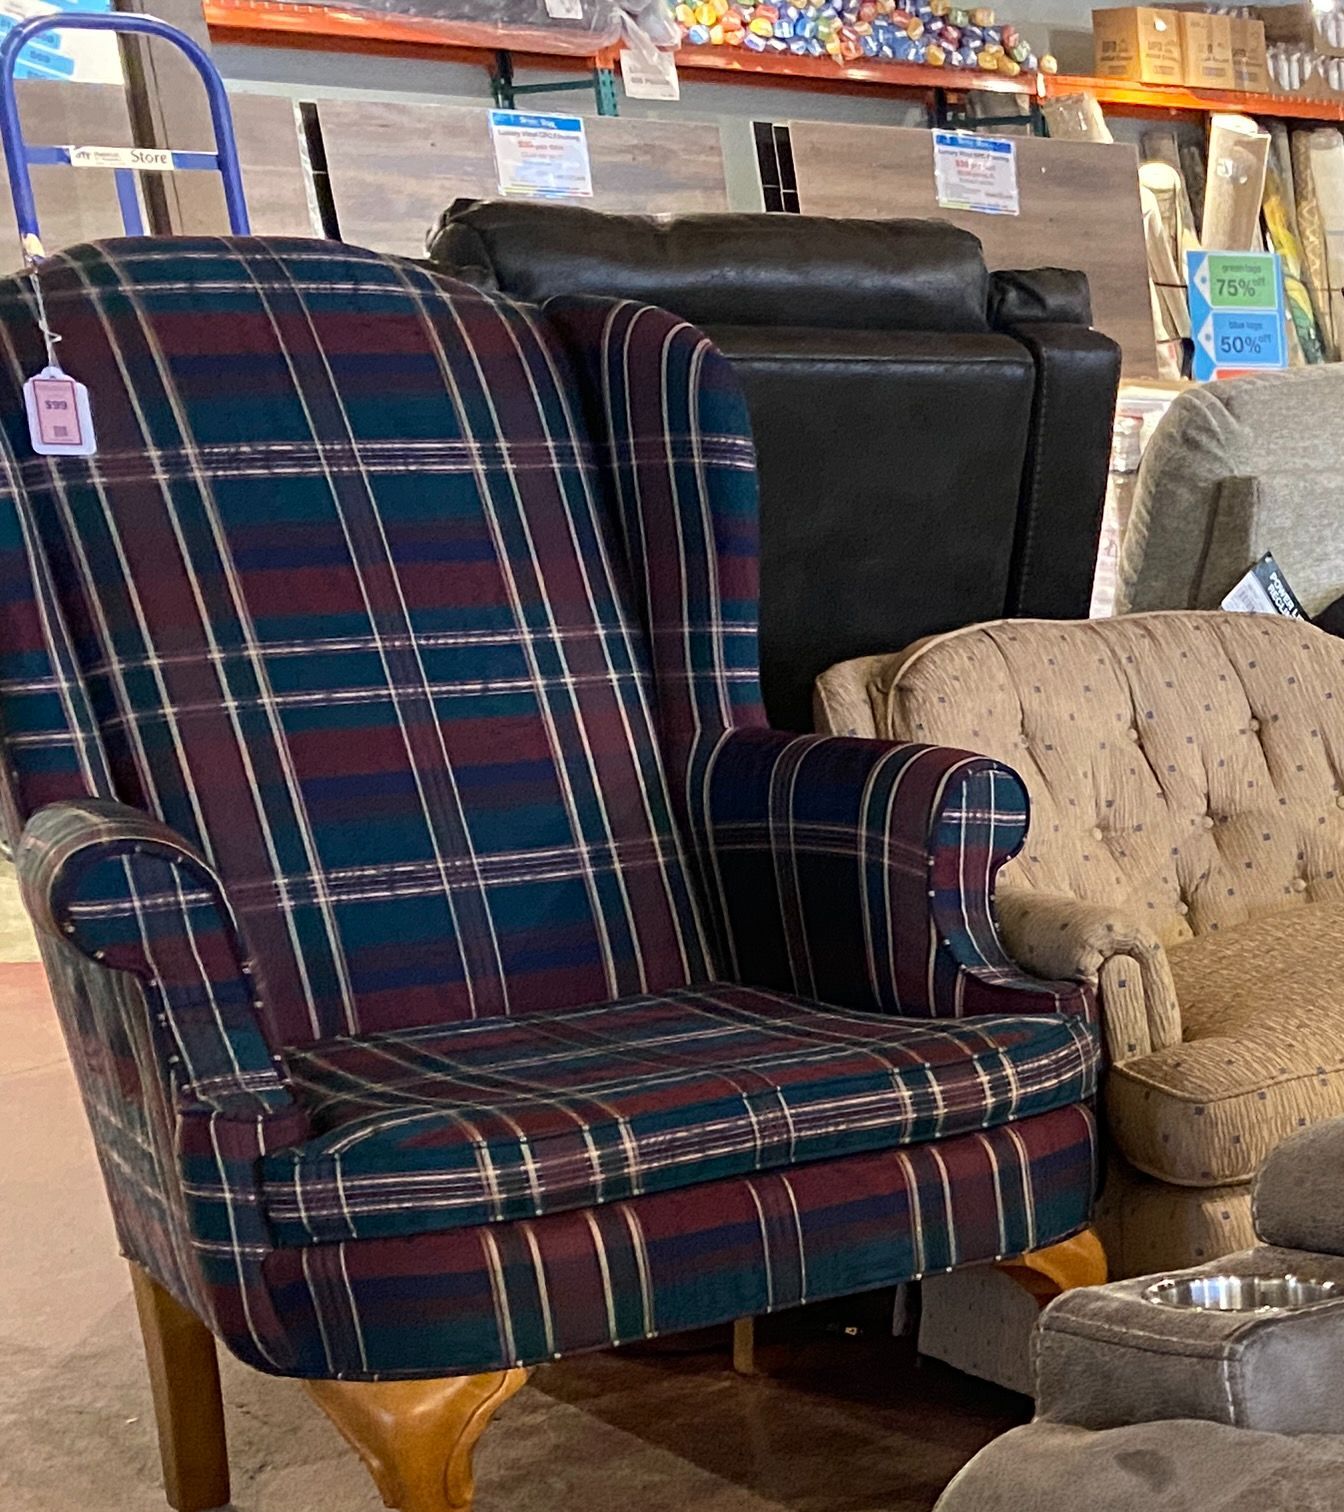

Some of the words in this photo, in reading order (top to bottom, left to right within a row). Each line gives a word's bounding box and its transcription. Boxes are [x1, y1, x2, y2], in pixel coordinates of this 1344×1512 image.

[130, 149, 167, 164] Store
[1216, 279, 1256, 297] 75%
[1220, 336, 1261, 353] 50%
[1269, 571, 1295, 611] POWER
